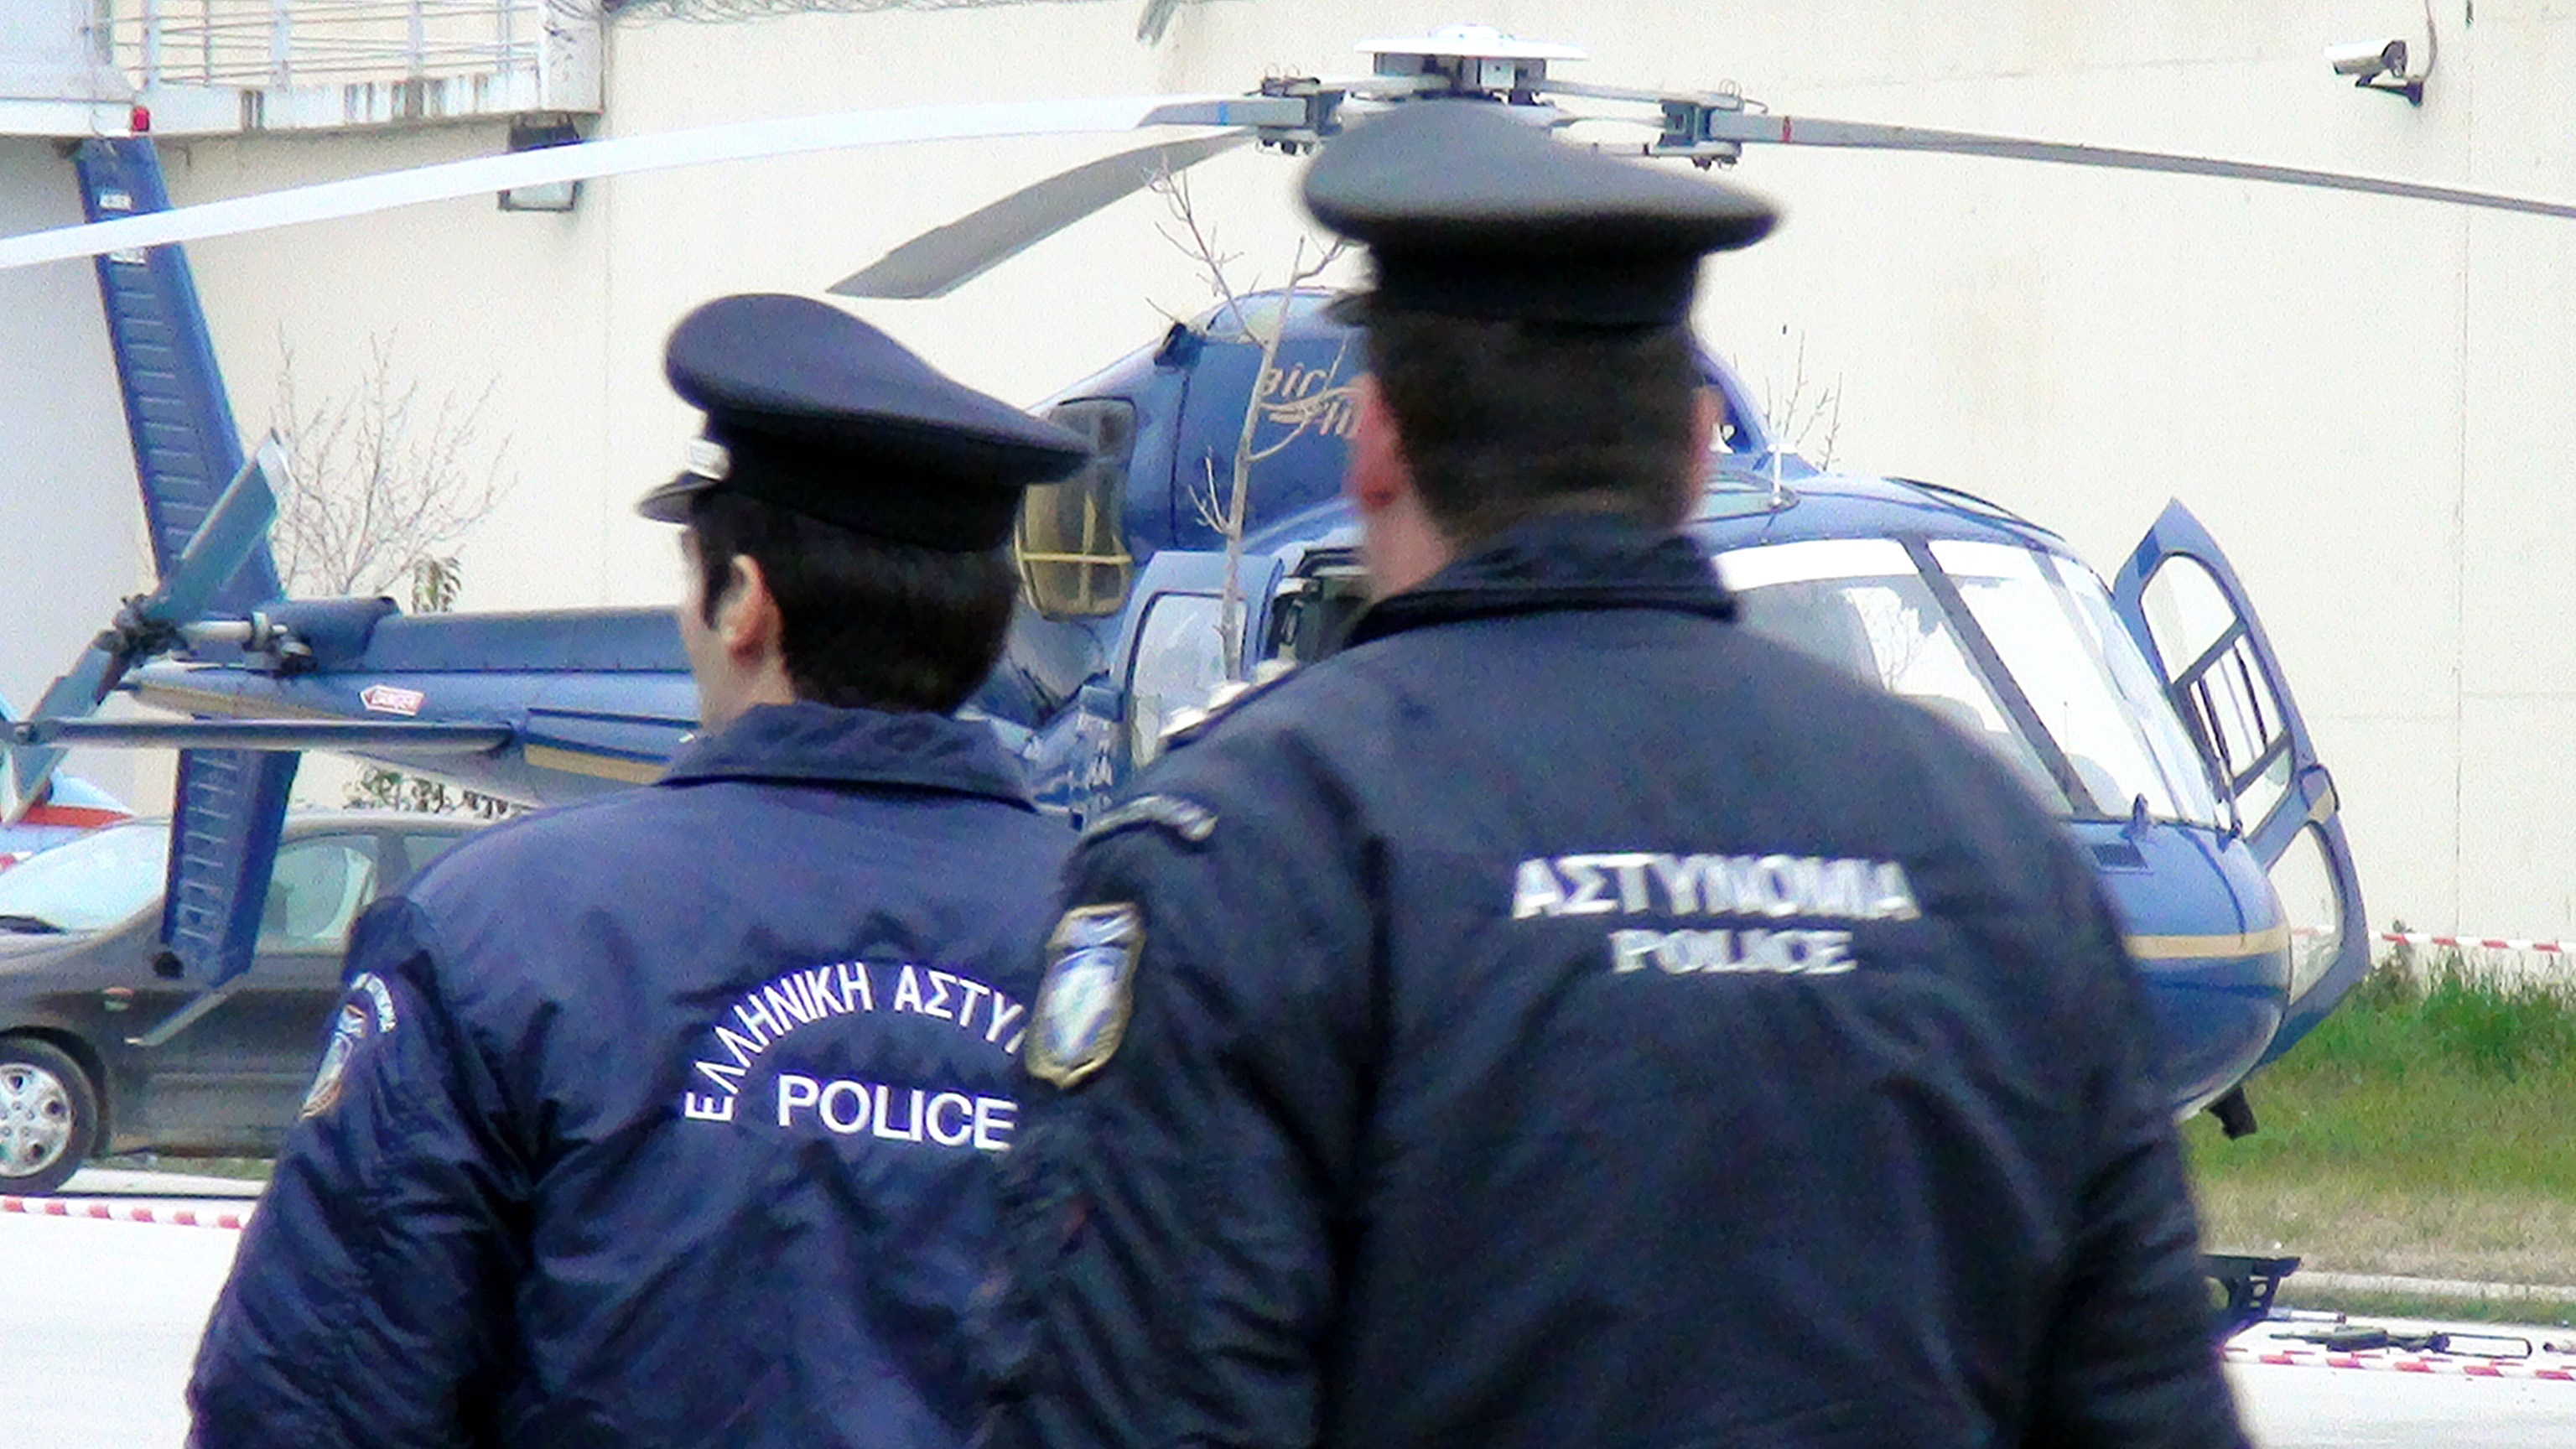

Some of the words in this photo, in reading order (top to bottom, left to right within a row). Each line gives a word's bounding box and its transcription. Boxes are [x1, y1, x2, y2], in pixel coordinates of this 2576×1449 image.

[1513, 852, 1922, 920] ΑΣΤΥΝΟΜΙΑ
[1608, 927, 1857, 975] POLICE
[684, 962, 873, 1122] ΕΛΛΗΝΙΚΗ
[777, 1074, 1019, 1151] POLICE
